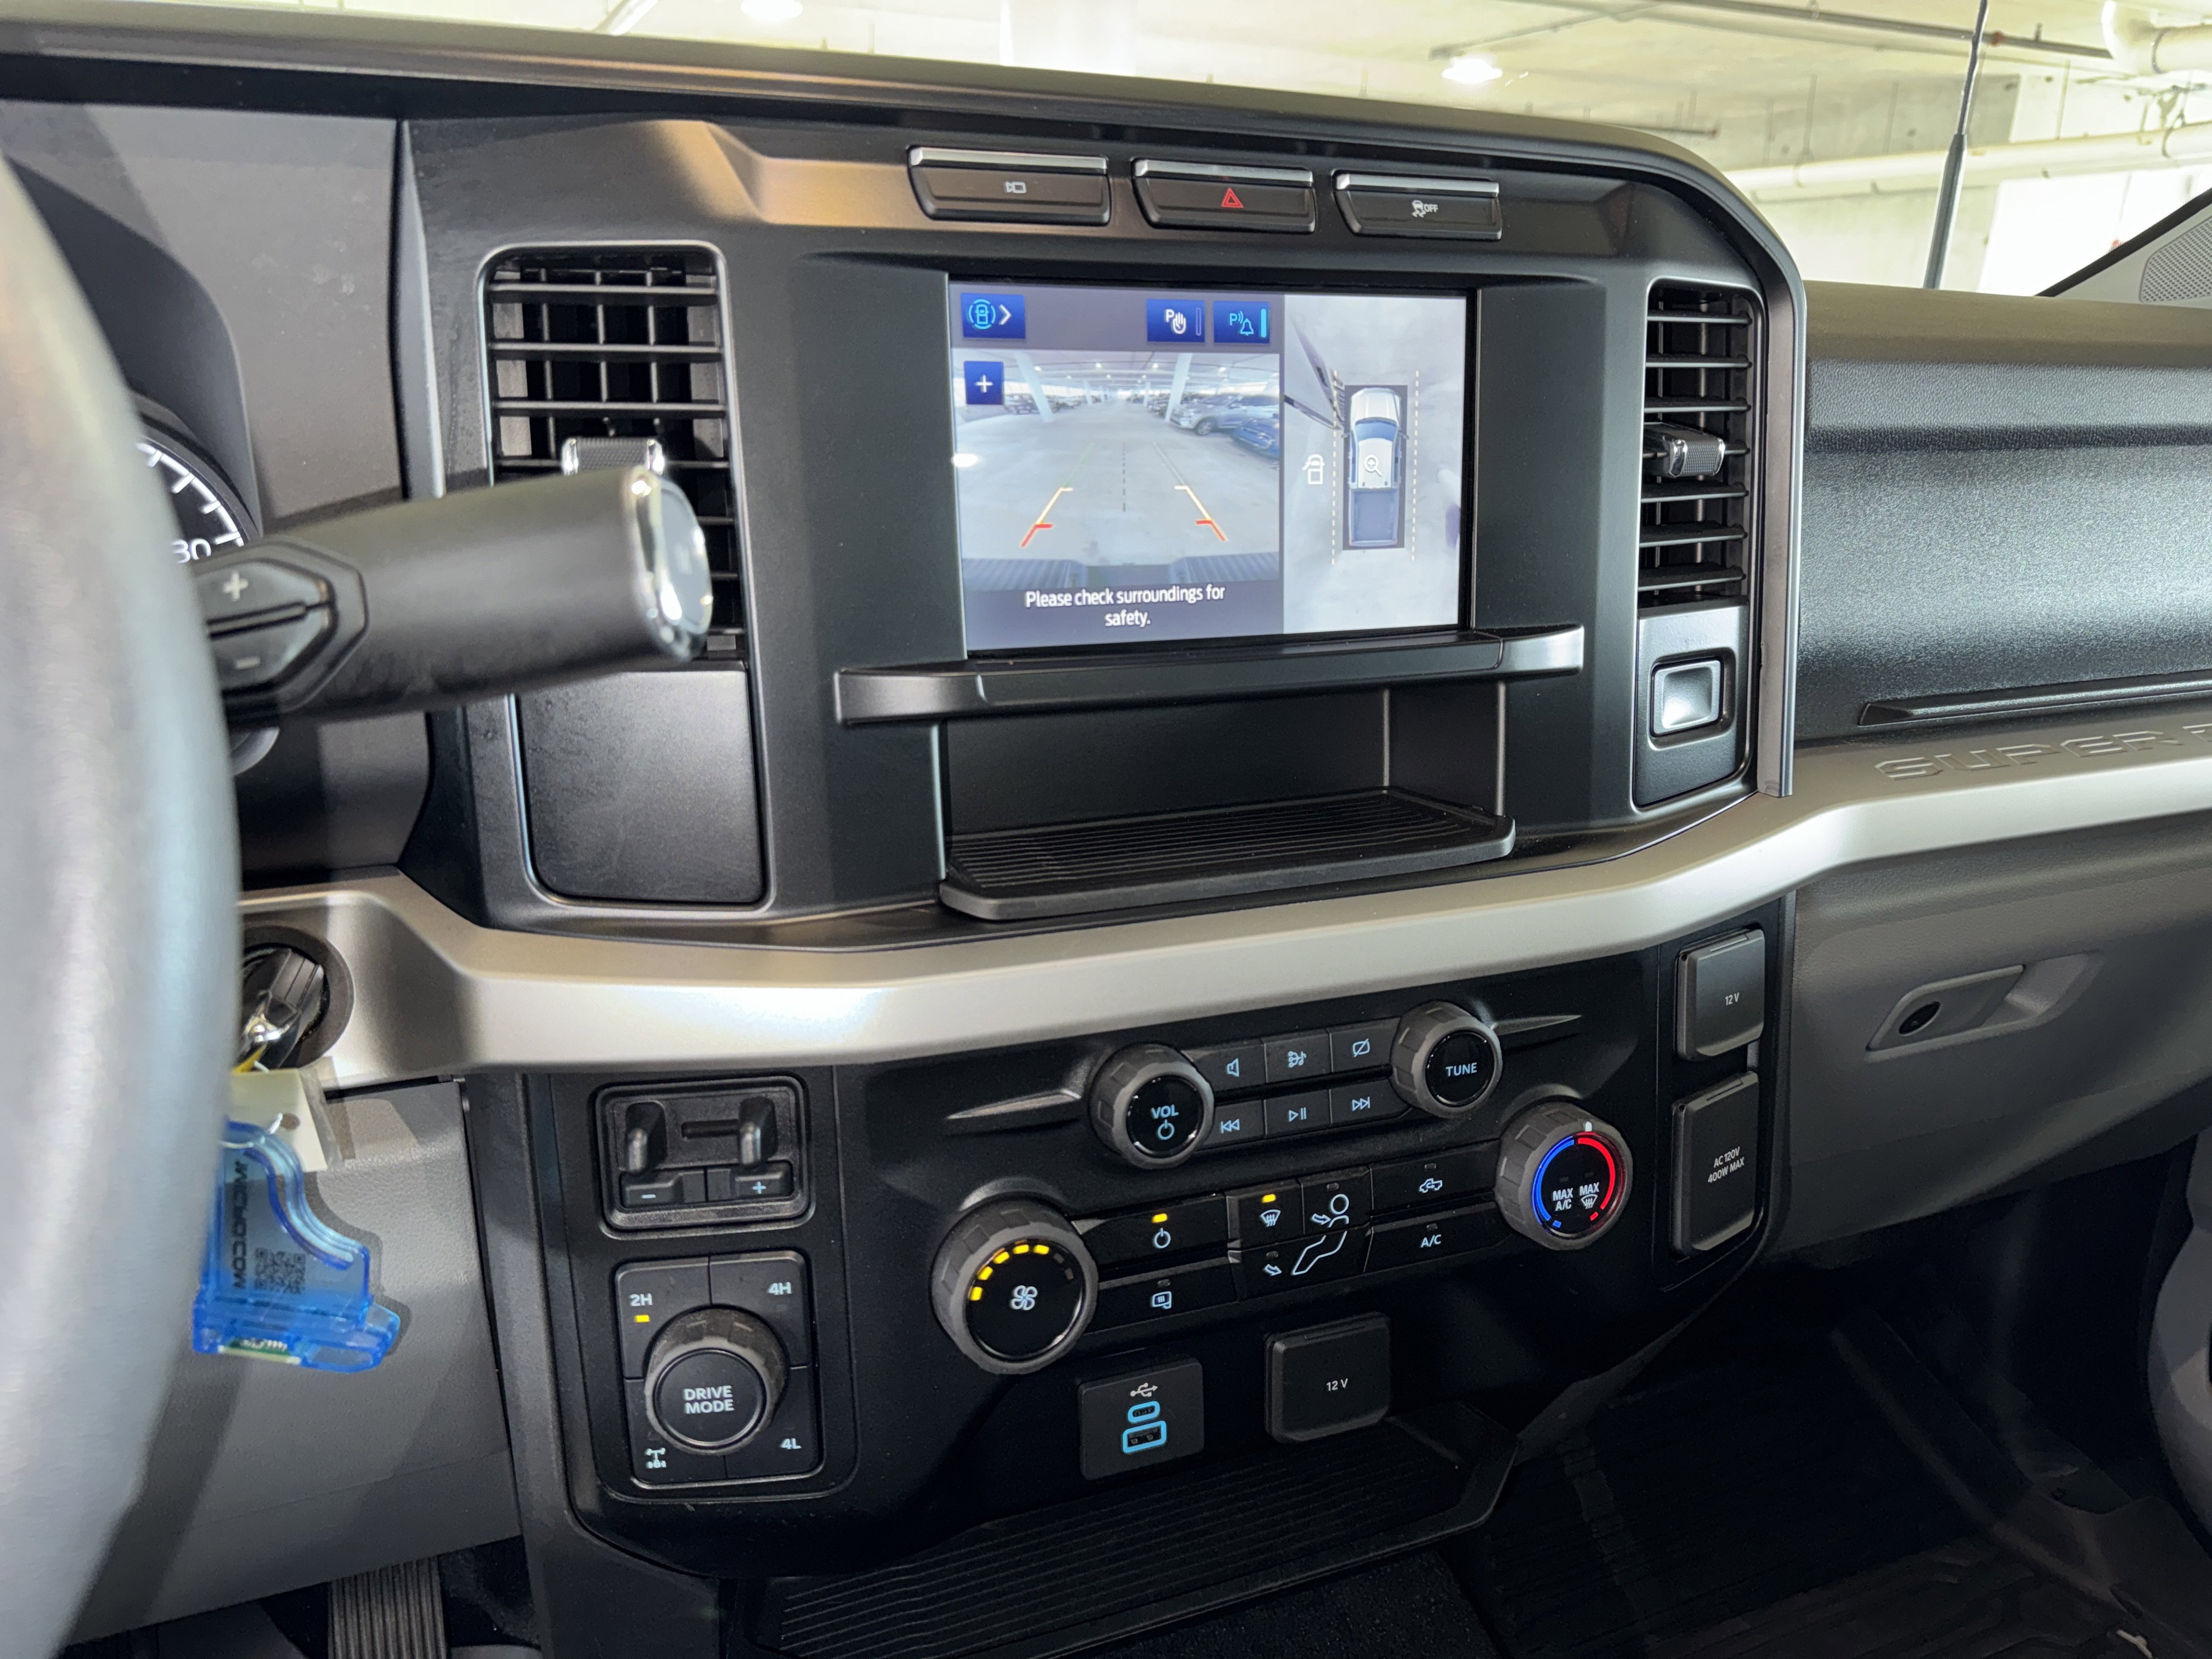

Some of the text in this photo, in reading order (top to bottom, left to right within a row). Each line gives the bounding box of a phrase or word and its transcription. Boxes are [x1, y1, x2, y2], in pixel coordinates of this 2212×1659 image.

[1424, 204, 1438, 213] OFF
[1025, 584, 1225, 608] Please check surroundings for
[1104, 609, 1151, 628] safety.
[1875, 730, 2183, 780] SUPER
[1725, 992, 1740, 1006] 12 V
[1446, 1062, 1477, 1077] TUNE
[1151, 1104, 1180, 1119] VOL
[1713, 1146, 1740, 1168] AC 120V
[1707, 1156, 1745, 1183] 400W MAX
[1553, 1188, 1573, 1201] MAX
[1579, 1182, 1600, 1196] MAX
[1555, 1199, 1572, 1212] A/C
[1420, 1234, 1442, 1248] A/C
[767, 1282, 792, 1295] 4H
[629, 1293, 653, 1307] 2H
[1327, 1378, 1348, 1391] 12 V
[683, 1385, 733, 1401] DRIVE
[685, 1399, 735, 1414] MODE
[780, 1438, 802, 1450] 4L
